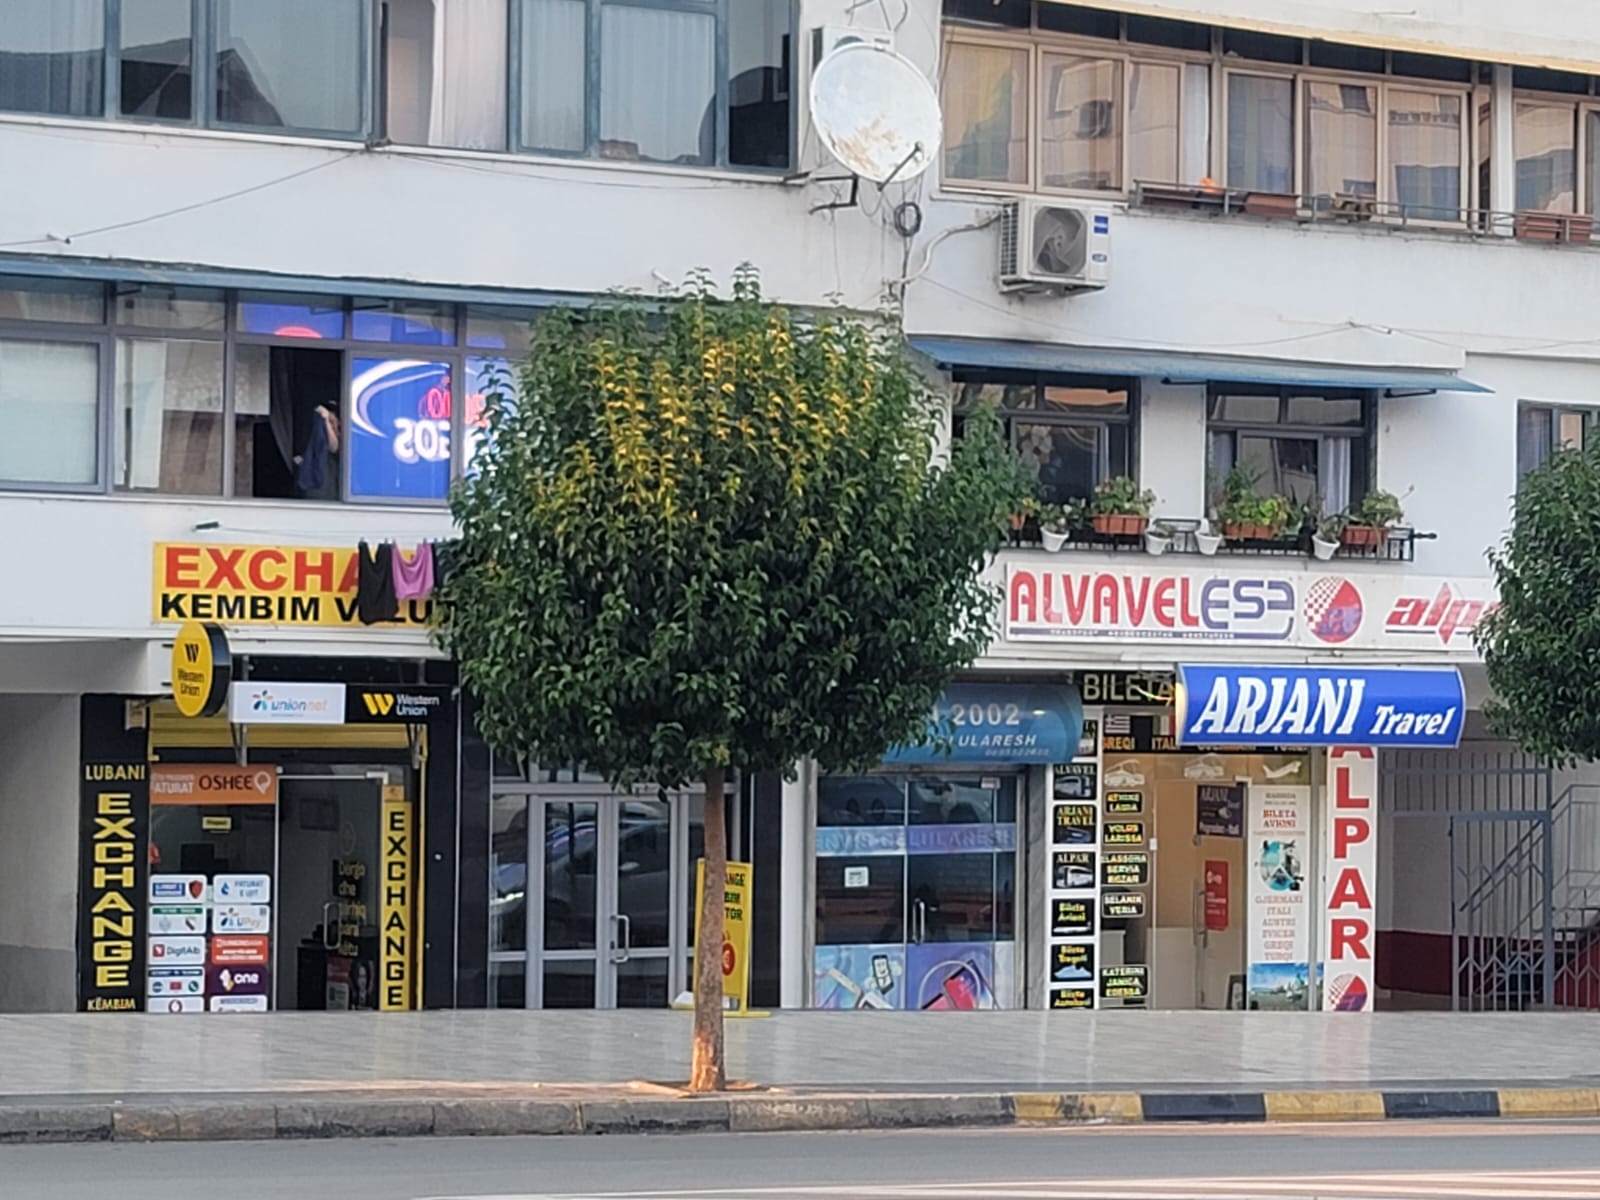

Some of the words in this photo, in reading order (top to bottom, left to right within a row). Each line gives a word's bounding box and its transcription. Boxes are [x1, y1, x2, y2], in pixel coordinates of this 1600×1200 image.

[164, 547, 361, 594] EXCHA
[161, 594, 321, 622] KEMBIM
[177, 668, 206, 684] Western
[180, 683, 201, 697] Union
[1083, 673, 1173, 702] BILETA
[396, 694, 439, 705] Western
[1190, 677, 1366, 735] ARJANI
[1369, 705, 1457, 735] Travel
[396, 705, 428, 718] Union
[951, 703, 1020, 727] 2002
[85, 765, 146, 781] LUBANI
[198, 775, 253, 790] OSHEE
[91, 793, 136, 987] EXCHANGE
[386, 811, 406, 1006] EXCHANGE
[234, 973, 259, 983] one
[87, 996, 136, 1012] KËMBIM
